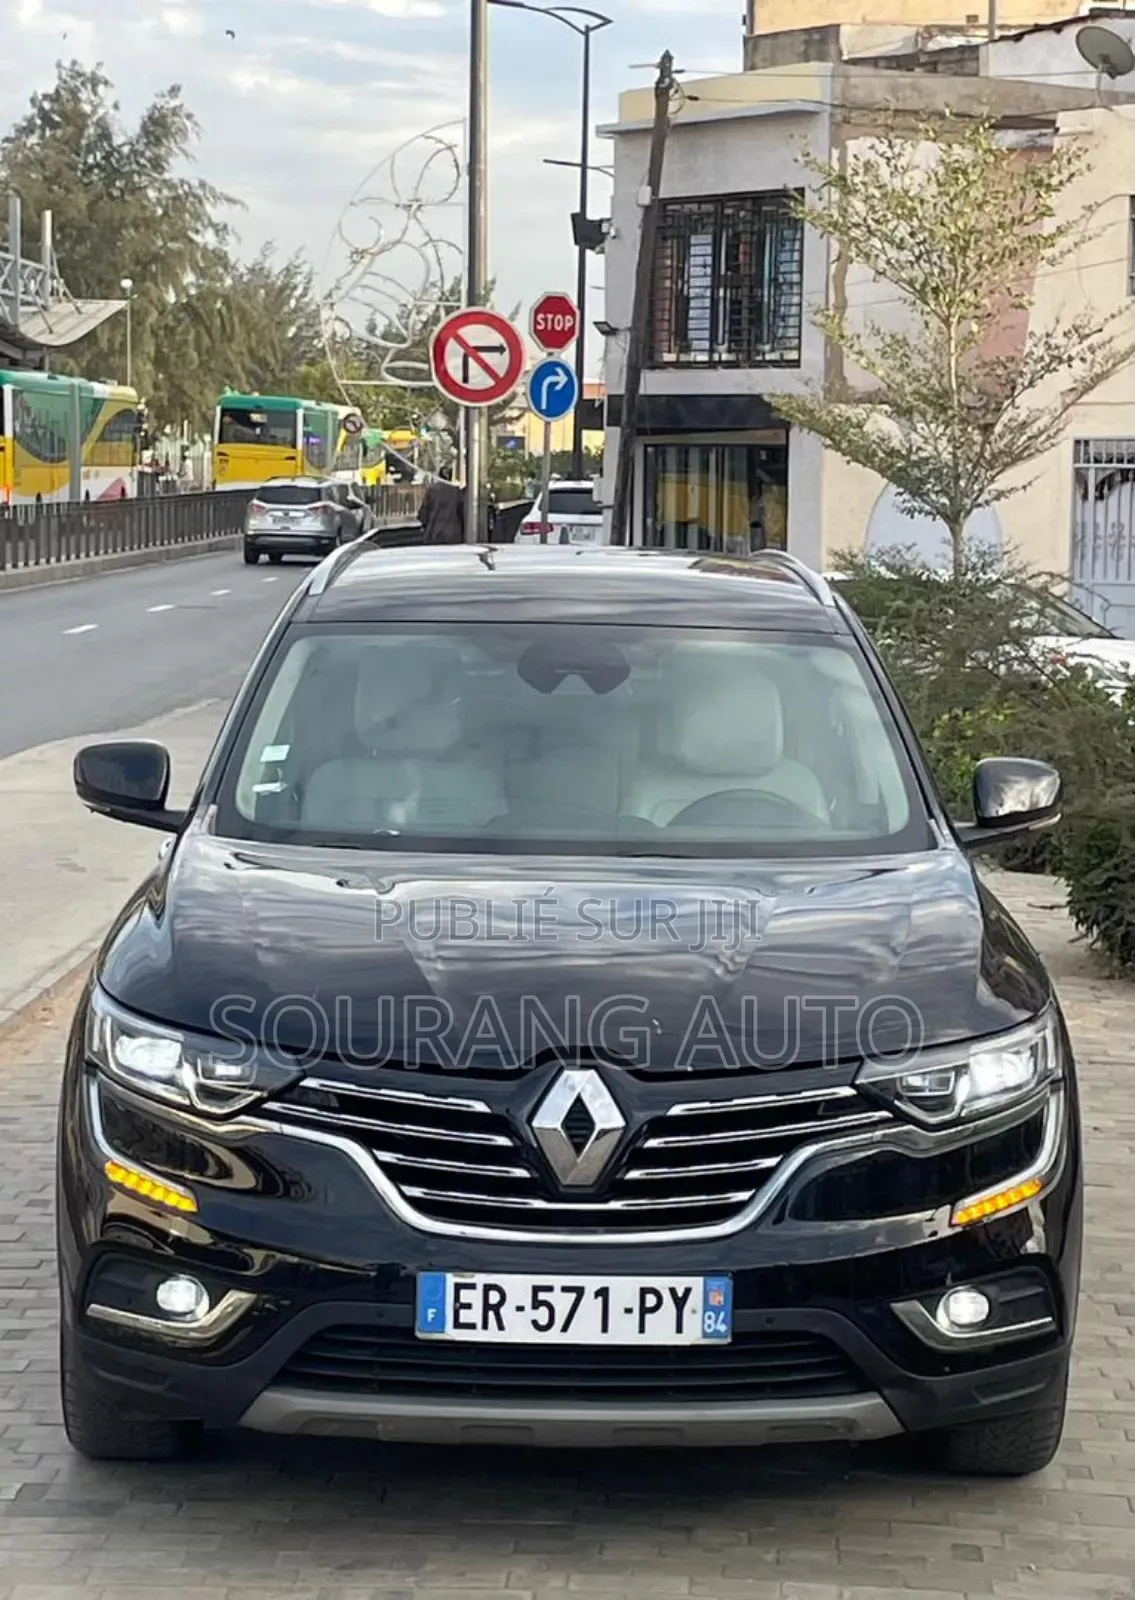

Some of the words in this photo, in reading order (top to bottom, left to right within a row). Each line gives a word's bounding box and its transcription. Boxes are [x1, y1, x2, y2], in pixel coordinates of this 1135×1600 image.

[536, 313, 574, 331] STOP
[427, 1308, 437, 1322] F
[452, 1282, 693, 1334] ER-571-PY
[703, 1311, 727, 1333] 84
